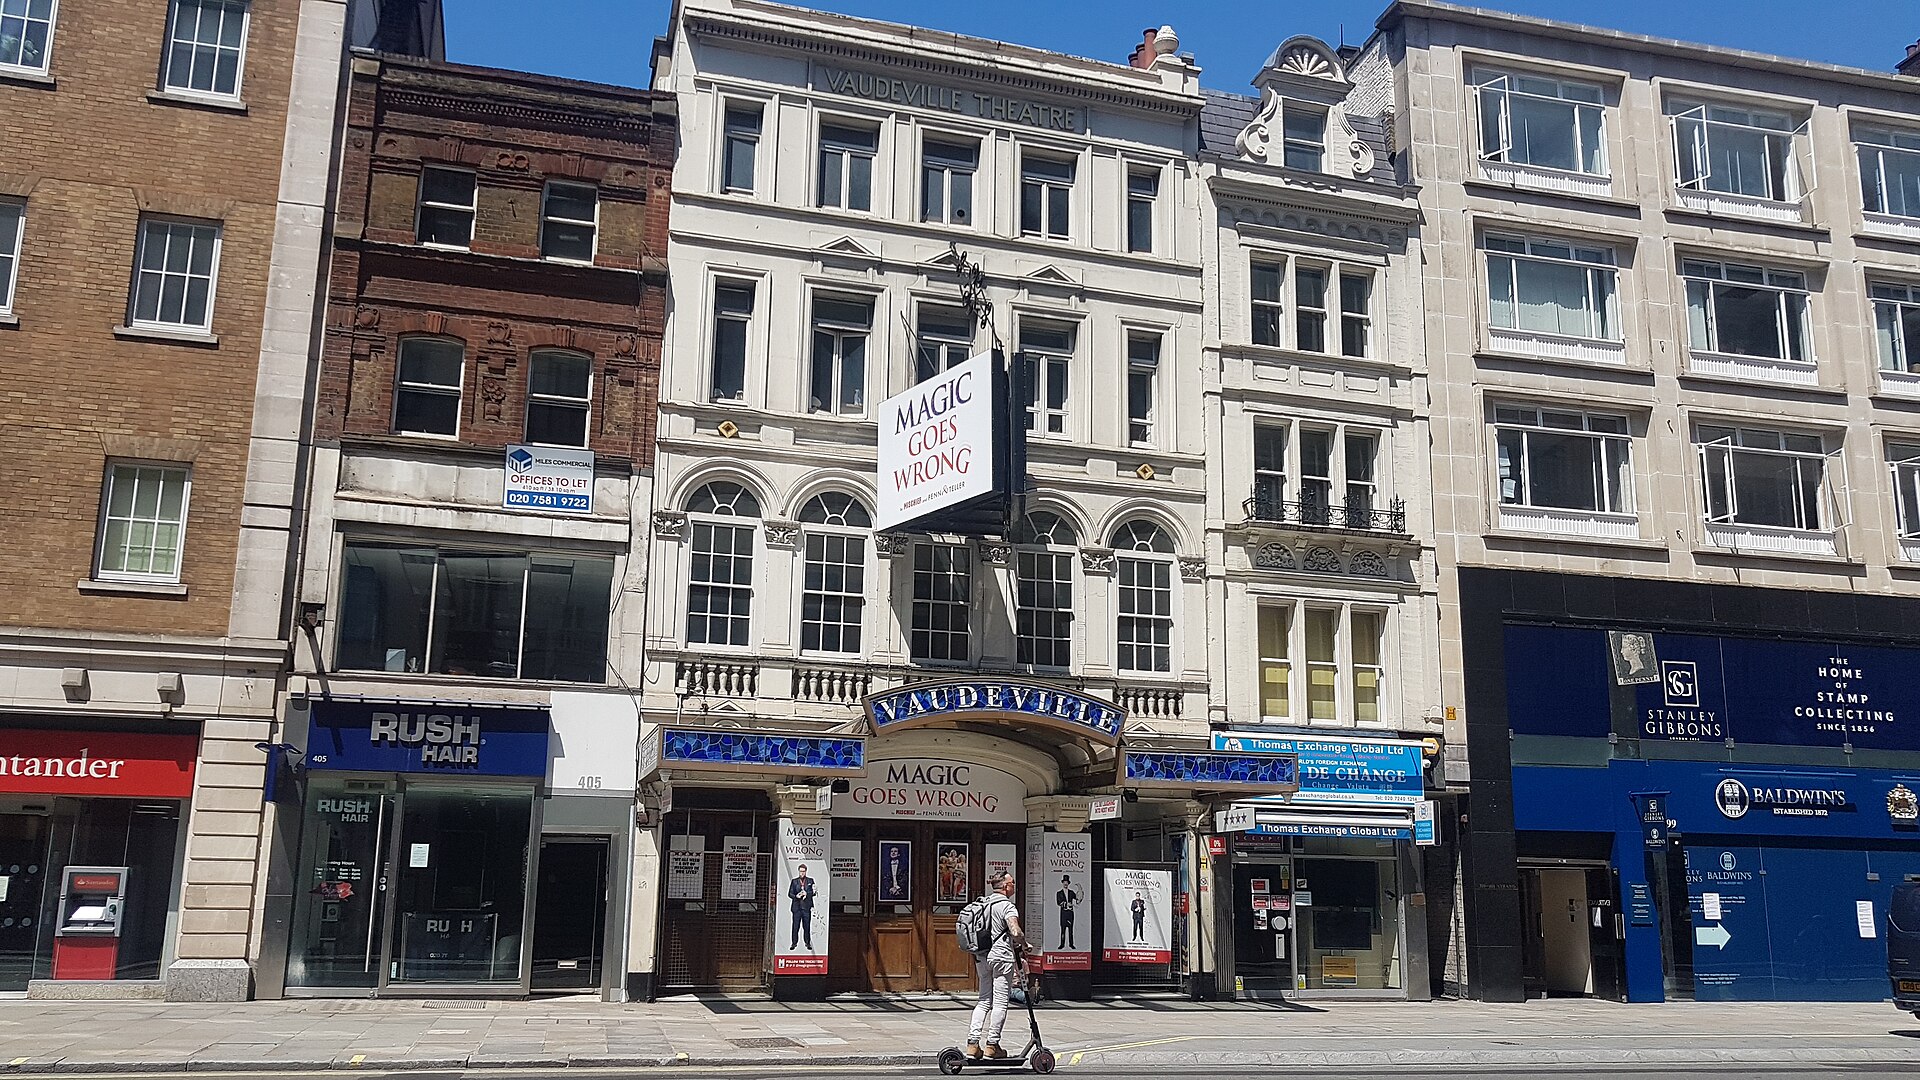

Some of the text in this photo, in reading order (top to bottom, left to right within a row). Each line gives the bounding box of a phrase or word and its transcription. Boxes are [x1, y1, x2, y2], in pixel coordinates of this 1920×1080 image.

[825, 69, 1075, 131] VAUDEVILLE THEATRE
[894, 372, 972, 436] MAGIC
[908, 414, 957, 456] GOES
[894, 446, 971, 492] WRONG
[511, 474, 587, 488] OFFICES TO LET
[510, 494, 586, 507] 020 7581 9722
[1818, 667, 1862, 678] HOME
[1817, 692, 1868, 704] STAMP
[880, 684, 1116, 731] VAUDEVILLE
[1794, 706, 1894, 721] COLLECTING
[1648, 710, 1715, 722] STANLEY
[370, 712, 480, 745] RUSH
[1646, 721, 1721, 736] GIBBONS
[1817, 723, 1846, 731] SINCE
[1251, 740, 1403, 754] Thomas Exchange Global Ltd
[312, 755, 327, 763] 405
[421, 745, 477, 763] HAIR
[886, 763, 970, 786] MAGIC
[1306, 766, 1330, 779] DE
[1336, 768, 1406, 782] CHANGE
[578, 776, 601, 789] 405
[1312, 782, 1339, 790] Change
[853, 787, 906, 804] GOES
[916, 790, 998, 813] WRONG
[1752, 788, 1846, 806] BALDWIN'S
[317, 800, 370, 813] RUSH
[341, 814, 368, 822] HAIR
[787, 828, 824, 837] MAGIC
[1261, 824, 1299, 833] Thomas
[1302, 825, 1347, 836] Exchange
[1350, 826, 1380, 835] Global
[786, 846, 824, 856] WRONG
[1050, 841, 1085, 850] MAGIC
[1050, 860, 1084, 869] WRONG
[1707, 872, 1752, 880] BALDWIN'S
[1134, 880, 1160, 888] WRONG
[426, 920, 472, 932] RUH
